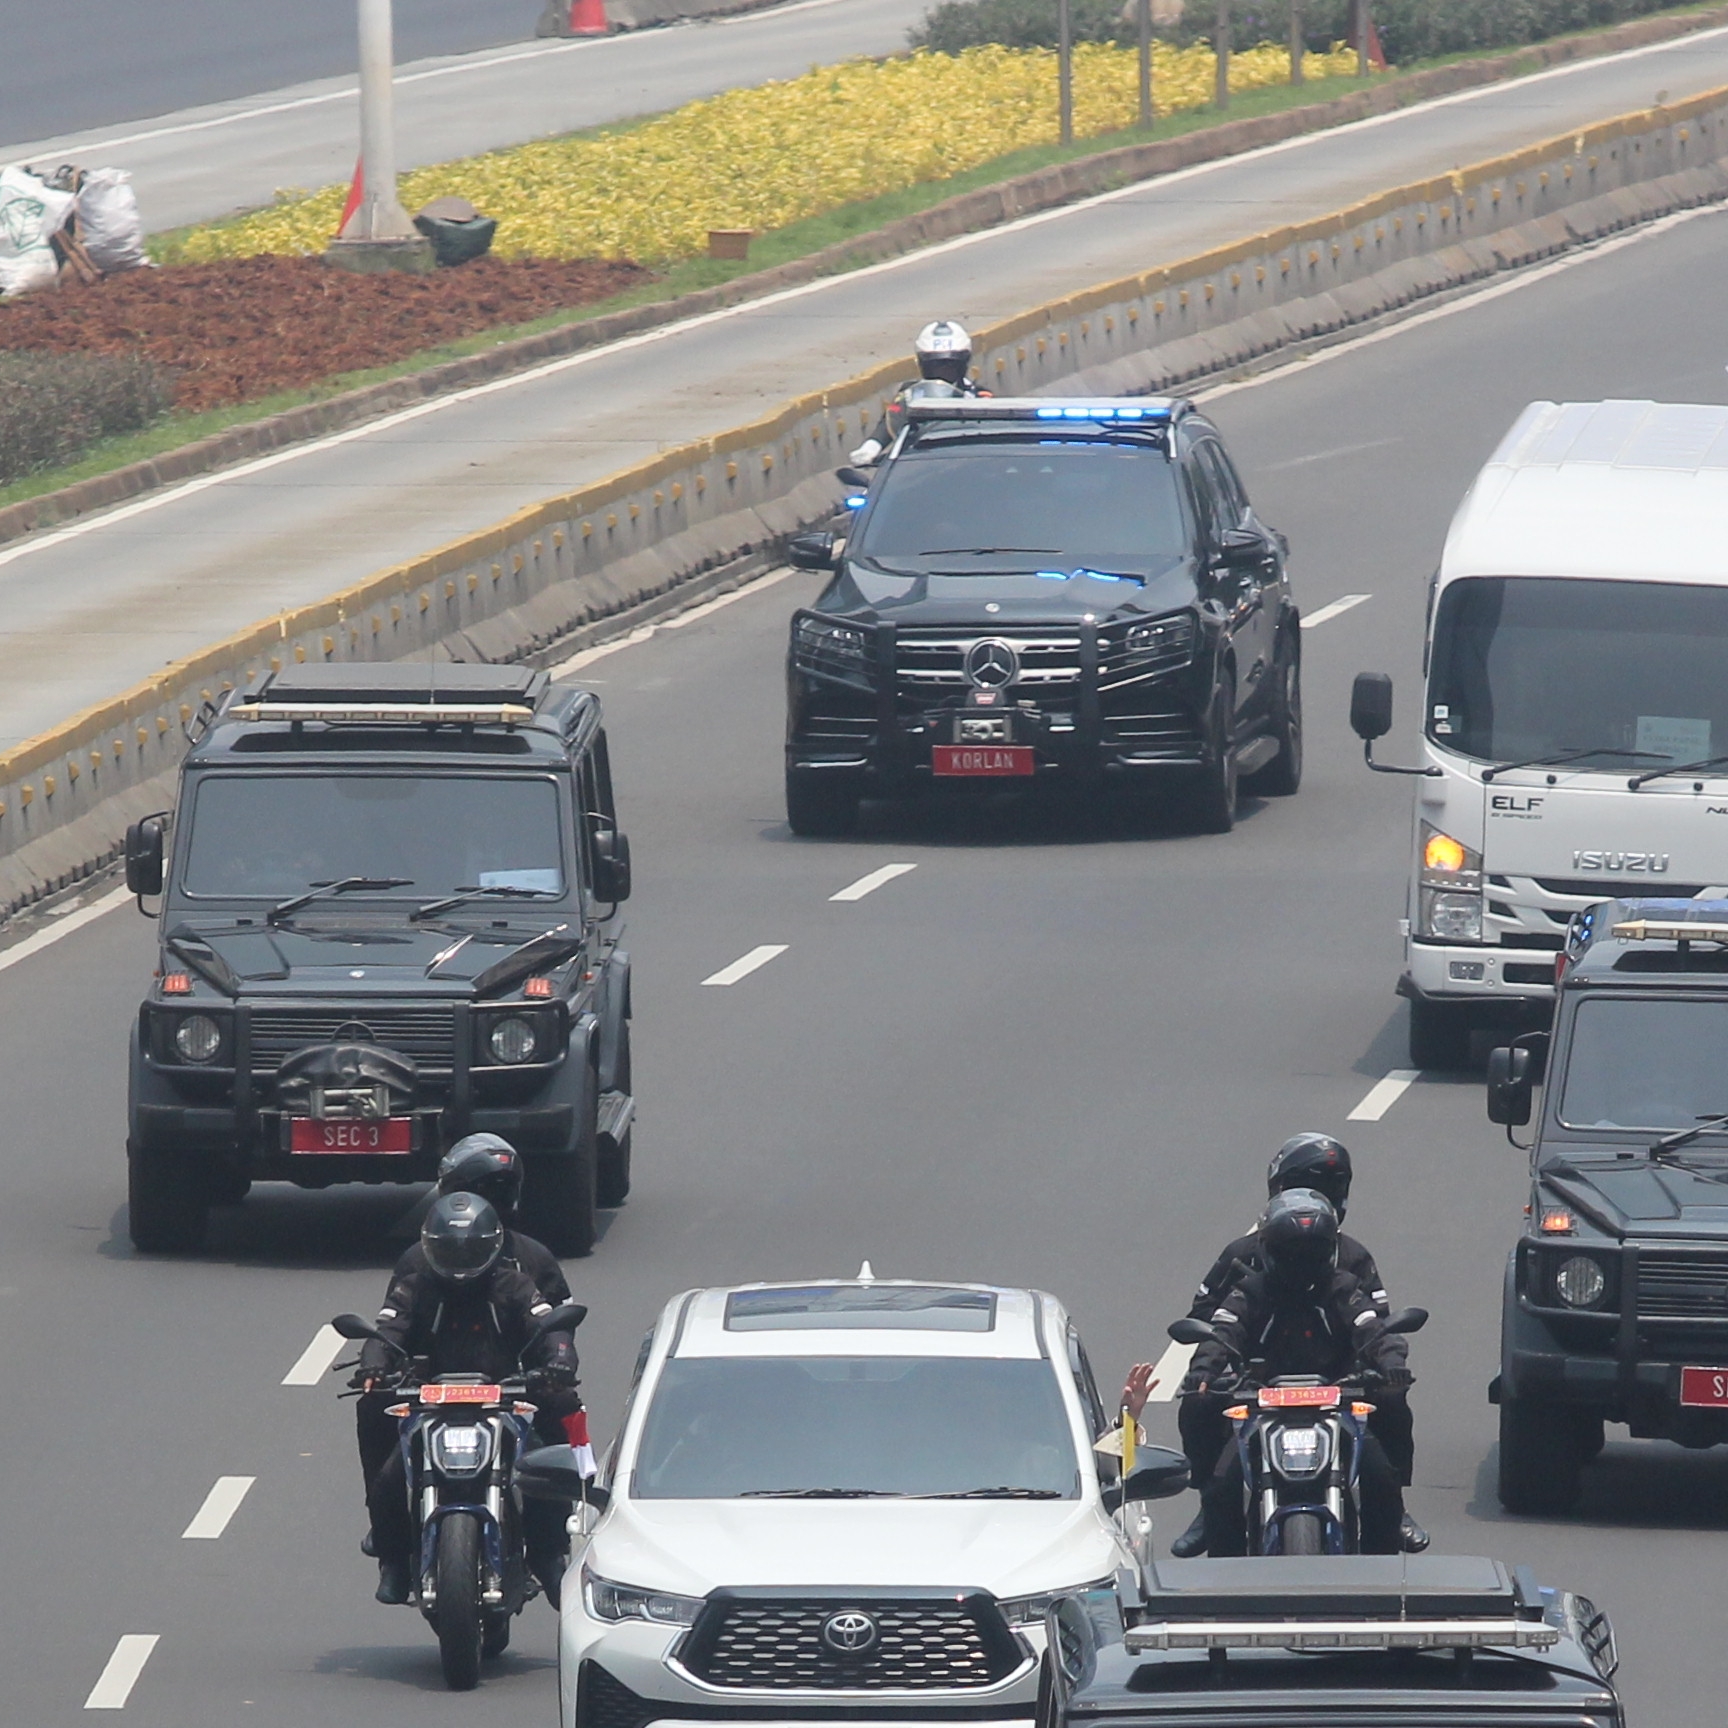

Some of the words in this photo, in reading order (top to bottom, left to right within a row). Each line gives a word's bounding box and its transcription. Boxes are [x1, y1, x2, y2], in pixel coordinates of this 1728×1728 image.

[952, 752, 1014, 769] KORLAN
[1492, 796, 1544, 811] ELF
[1573, 850, 1669, 872] ISUZU
[324, 1126, 360, 1146] SEC
[369, 1126, 379, 1146] 3
